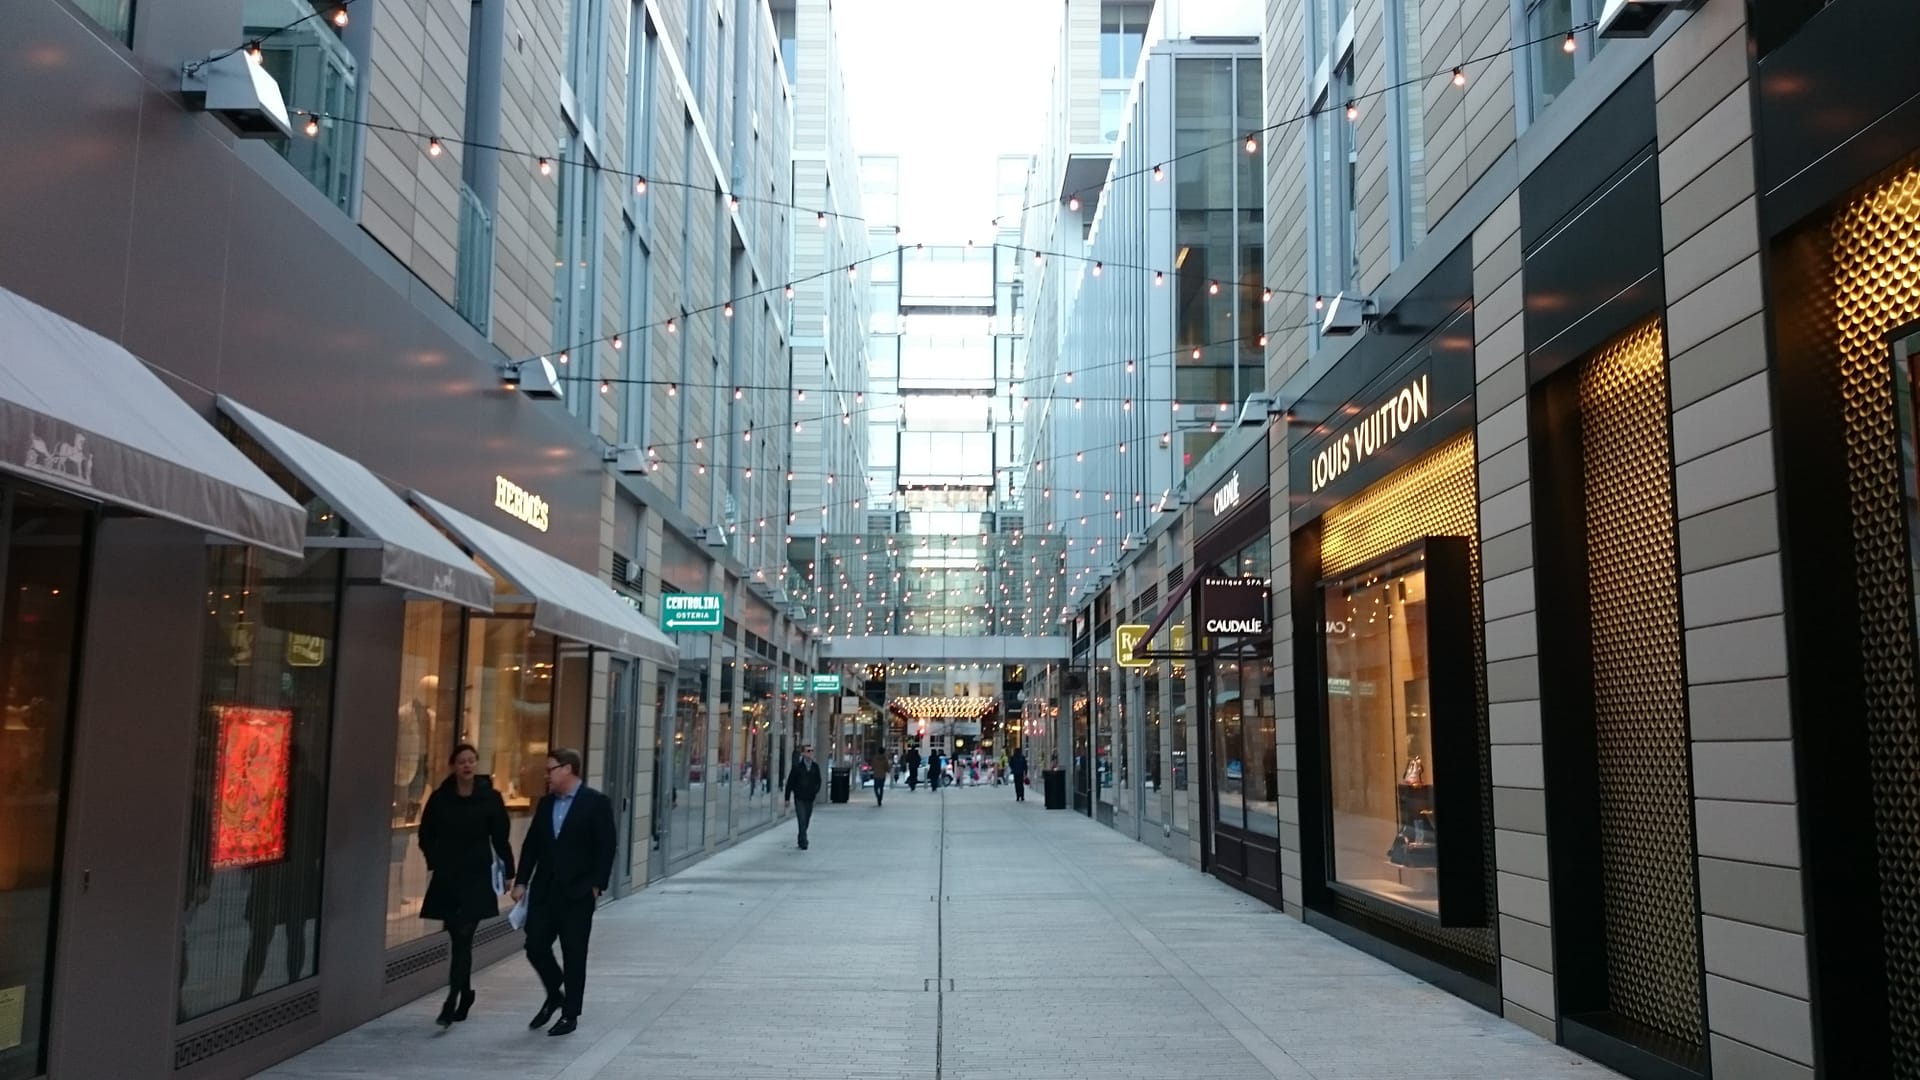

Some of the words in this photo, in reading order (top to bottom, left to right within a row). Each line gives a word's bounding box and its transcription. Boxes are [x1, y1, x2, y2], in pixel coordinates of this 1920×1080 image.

[1311, 433, 1350, 493] LOUIS
[1353, 374, 1428, 463] VUITTON
[1205, 578, 1243, 587] Boutique
[1246, 578, 1262, 587] SPA
[666, 596, 720, 610] CENTROLINA
[676, 611, 709, 620] OSTERIA
